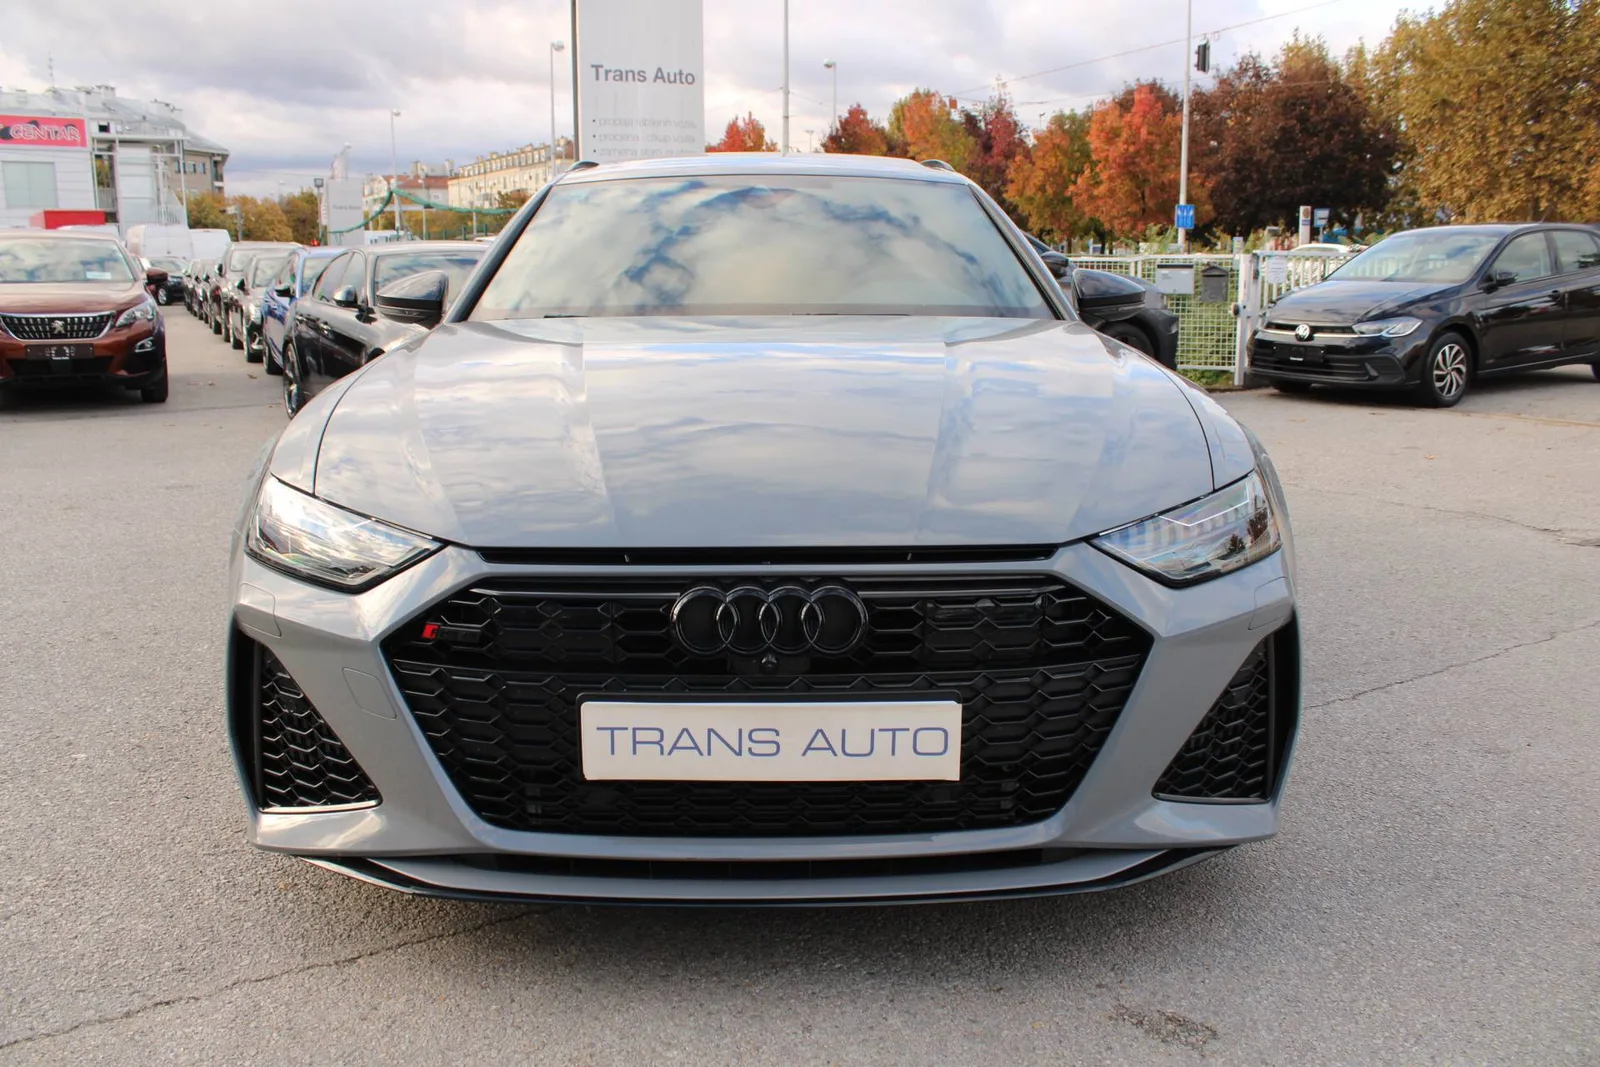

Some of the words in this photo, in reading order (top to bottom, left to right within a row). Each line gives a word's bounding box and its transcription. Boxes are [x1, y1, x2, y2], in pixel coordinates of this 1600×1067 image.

[591, 64, 647, 83] Trans
[653, 66, 696, 85] Auto
[10, 123, 80, 142] CENTAR
[596, 726, 781, 758] TRANS
[801, 726, 950, 758] AUTO
